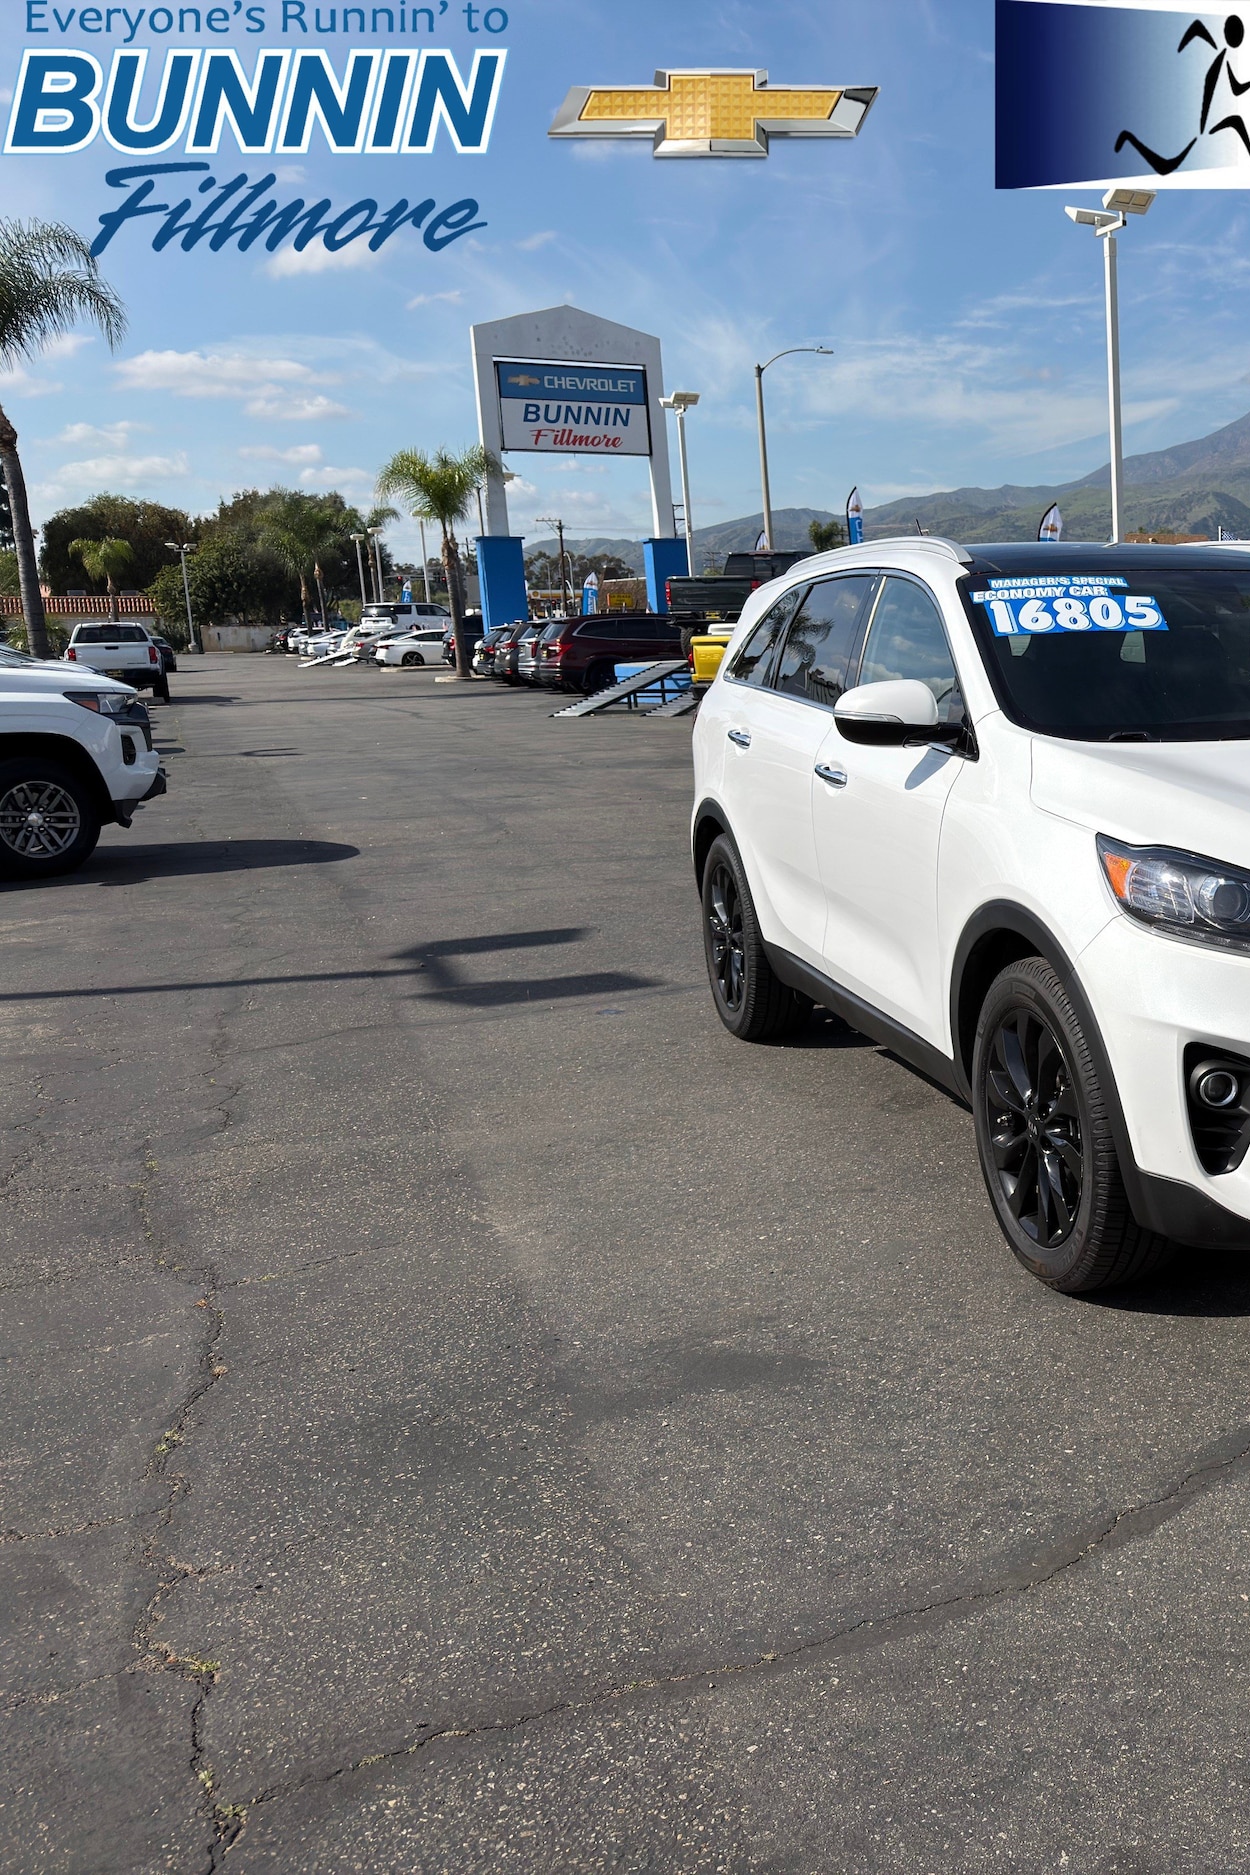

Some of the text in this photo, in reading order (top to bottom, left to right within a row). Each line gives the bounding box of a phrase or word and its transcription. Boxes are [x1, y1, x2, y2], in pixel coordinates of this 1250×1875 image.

[543, 375, 637, 393] CHEVROLET
[522, 403, 631, 427] BUNNIN
[529, 428, 624, 448] Fillmore
[990, 577, 1128, 589] MANAGER'S SPECIAL
[972, 585, 1109, 602] ECONOMY CAR
[989, 596, 1163, 634] 16805
